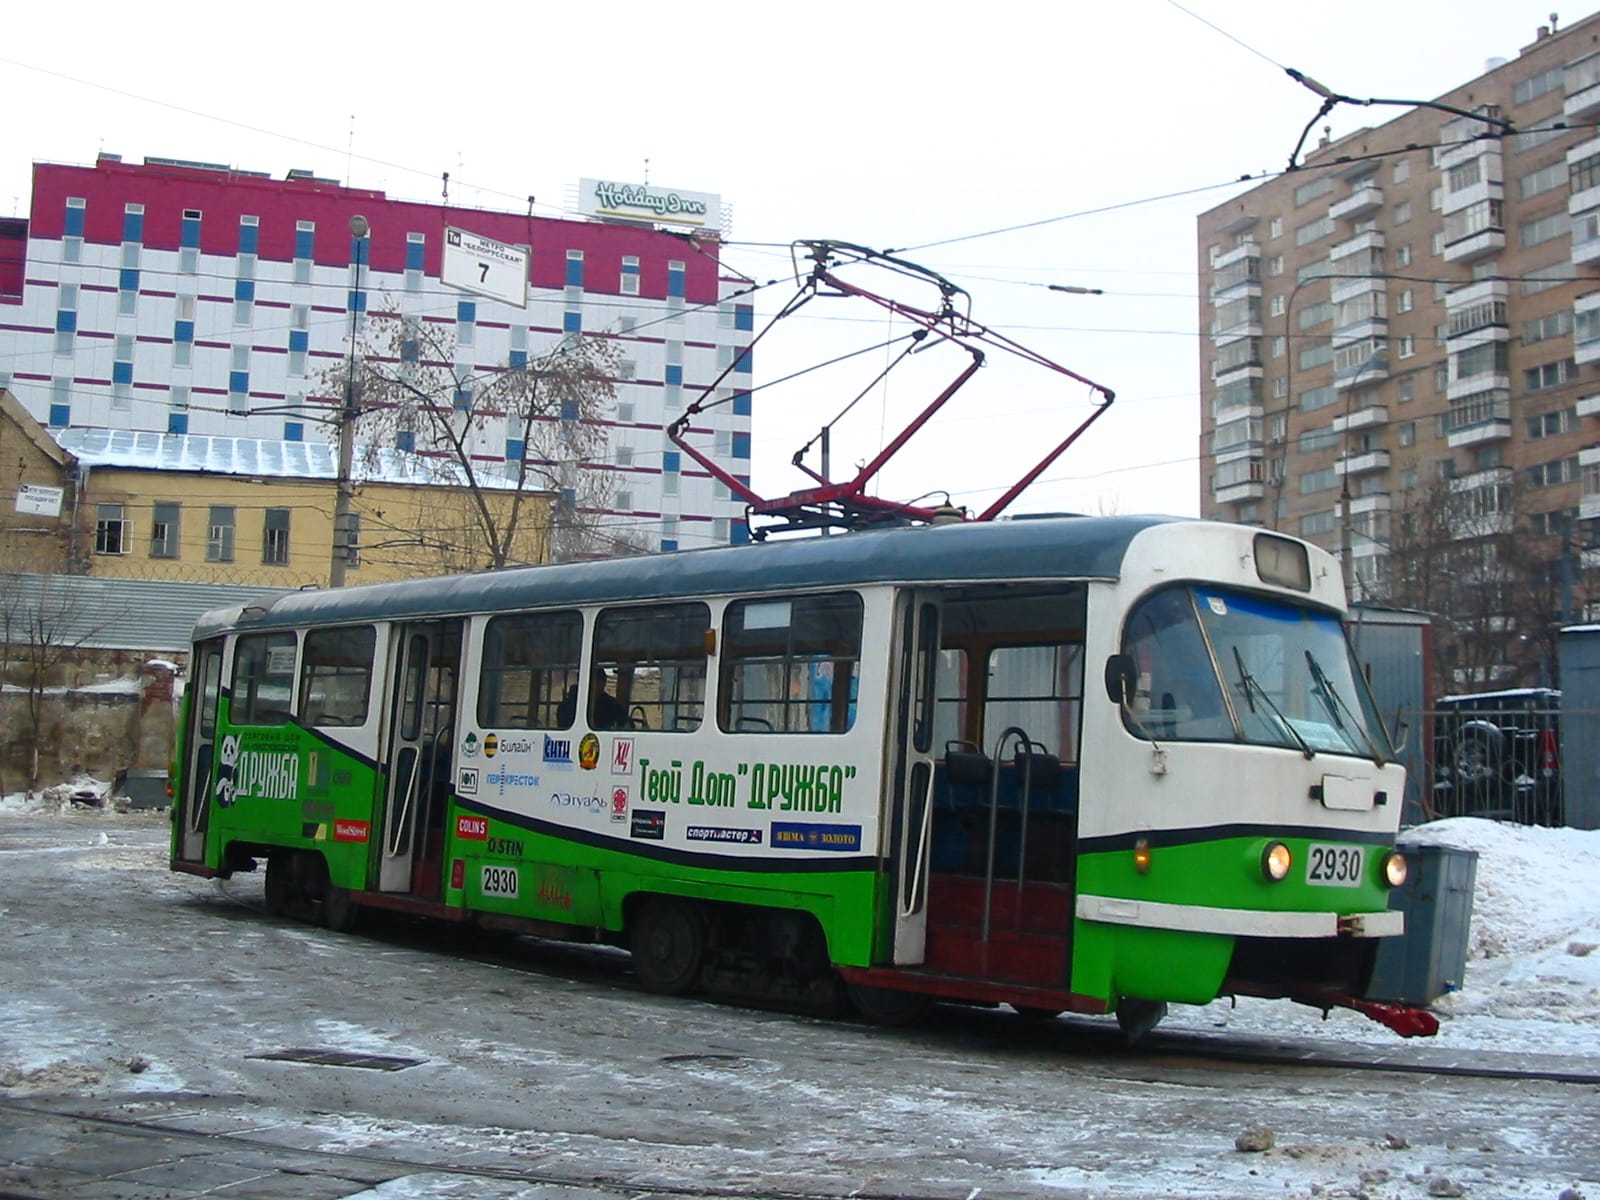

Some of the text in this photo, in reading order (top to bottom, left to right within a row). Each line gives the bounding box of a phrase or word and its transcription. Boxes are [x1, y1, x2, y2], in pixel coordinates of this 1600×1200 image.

[596, 181, 706, 214] Holiday Inn
[478, 262, 490, 283] 7
[500, 739, 532, 752] билайн
[235, 751, 299, 799] ДРУЖБА
[639, 758, 856, 813] Твой Дом "ДРУЖБА"
[687, 828, 748, 841] спортмастер
[777, 832, 855, 845] ЯШМА ЗОЛОТО
[1310, 848, 1360, 881] 2930
[484, 868, 517, 893] 2930
